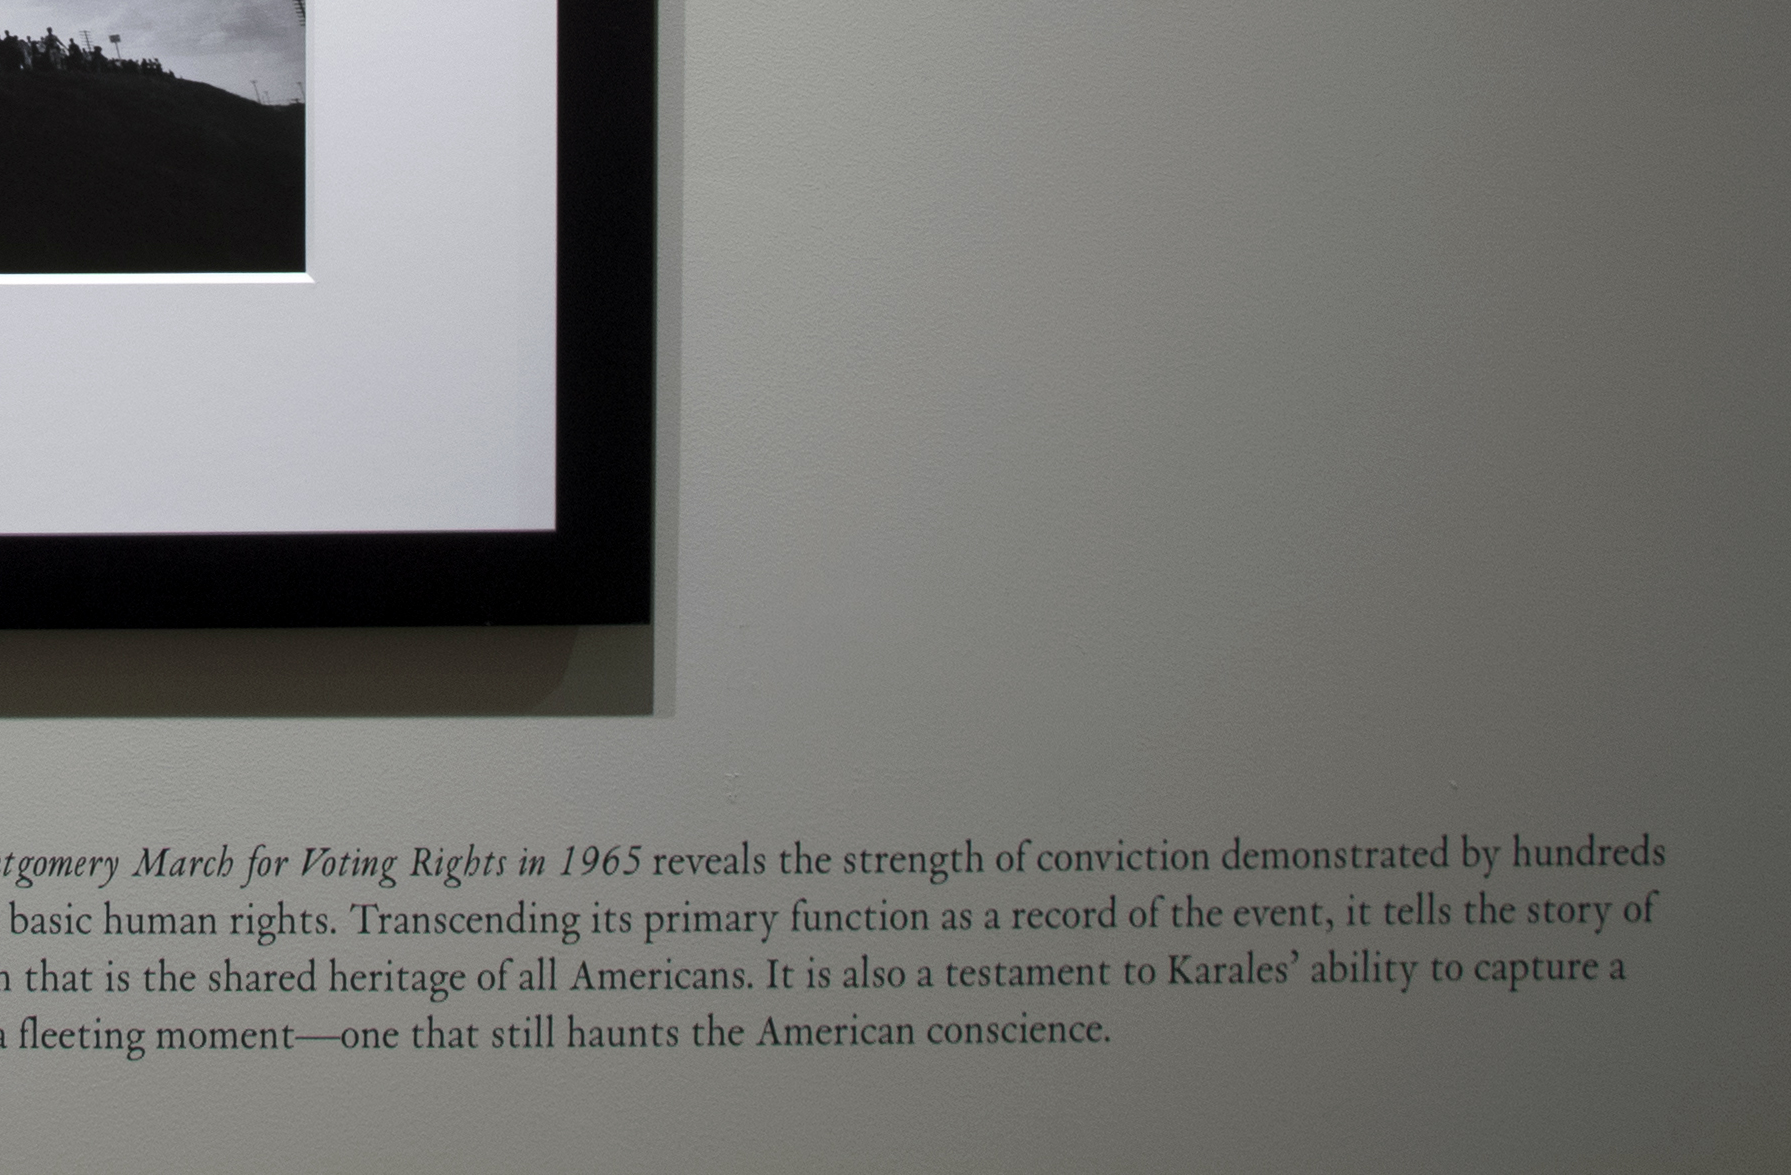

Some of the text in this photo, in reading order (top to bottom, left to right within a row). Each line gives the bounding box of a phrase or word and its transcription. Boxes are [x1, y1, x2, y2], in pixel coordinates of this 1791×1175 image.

[130, 843, 234, 878] March
[239, 843, 290, 890] for
[301, 847, 399, 889] Voting
[409, 843, 508, 889] Rights
[518, 847, 546, 877] in
[559, 844, 643, 877] 1965
[652, 840, 766, 876] reveals
[779, 840, 832, 875] the
[843, 838, 985, 886] strength
[995, 838, 1033, 873] of
[1036, 838, 1210, 873] conviction
[1221, 833, 1450, 871] demonstrated
[1460, 833, 1502, 880] by
[1512, 832, 1666, 868] hundreds
[8, 899, 93, 935] basic
[103, 900, 218, 936] human
[229, 899, 337, 947] rights.
[349, 899, 582, 946] Transcending
[591, 900, 632, 934] its
[643, 899, 780, 945] primary
[790, 897, 930, 933] function
[941, 908, 973, 931] as
[983, 908, 1001, 930] a
[1012, 894, 1118, 930] record
[1128, 894, 1166, 929] of
[1171, 893, 1224, 928] the
[1233, 901, 1334, 933] event,
[1346, 893, 1372, 927] it
[1383, 890, 1452, 926] tells
[1463, 889, 1516, 926] the
[1527, 899, 1613, 936] story
[1623, 888, 1660, 924] of
[24, 957, 93, 993] that
[105, 959, 130, 993] is
[142, 957, 197, 993] the
[208, 957, 318, 993] shared
[328, 957, 467, 1004] heritage
[476, 957, 515, 991] of
[518, 955, 557, 992] all
[569, 957, 753, 991] Americans.
[766, 958, 795, 990] It
[806, 956, 831, 989] is
[842, 953, 906, 989] also
[916, 965, 935, 988] a
[945, 960, 1111, 988] testament
[1124, 960, 1157, 986] to
[1167, 948, 1299, 986] Karales’
[1310, 947, 1419, 994] ability
[1430, 957, 1464, 983] to
[1473, 956, 1599, 994] capture
[1609, 958, 1627, 981] a
[18, 1015, 146, 1062] fleeting
[411, 1013, 480, 1049] that
[491, 1013, 555, 1049] still
[567, 1013, 679, 1048] haunts
[692, 1012, 745, 1048] the
[755, 1012, 915, 1047] American
[926, 1011, 1111, 1045] conscience.
